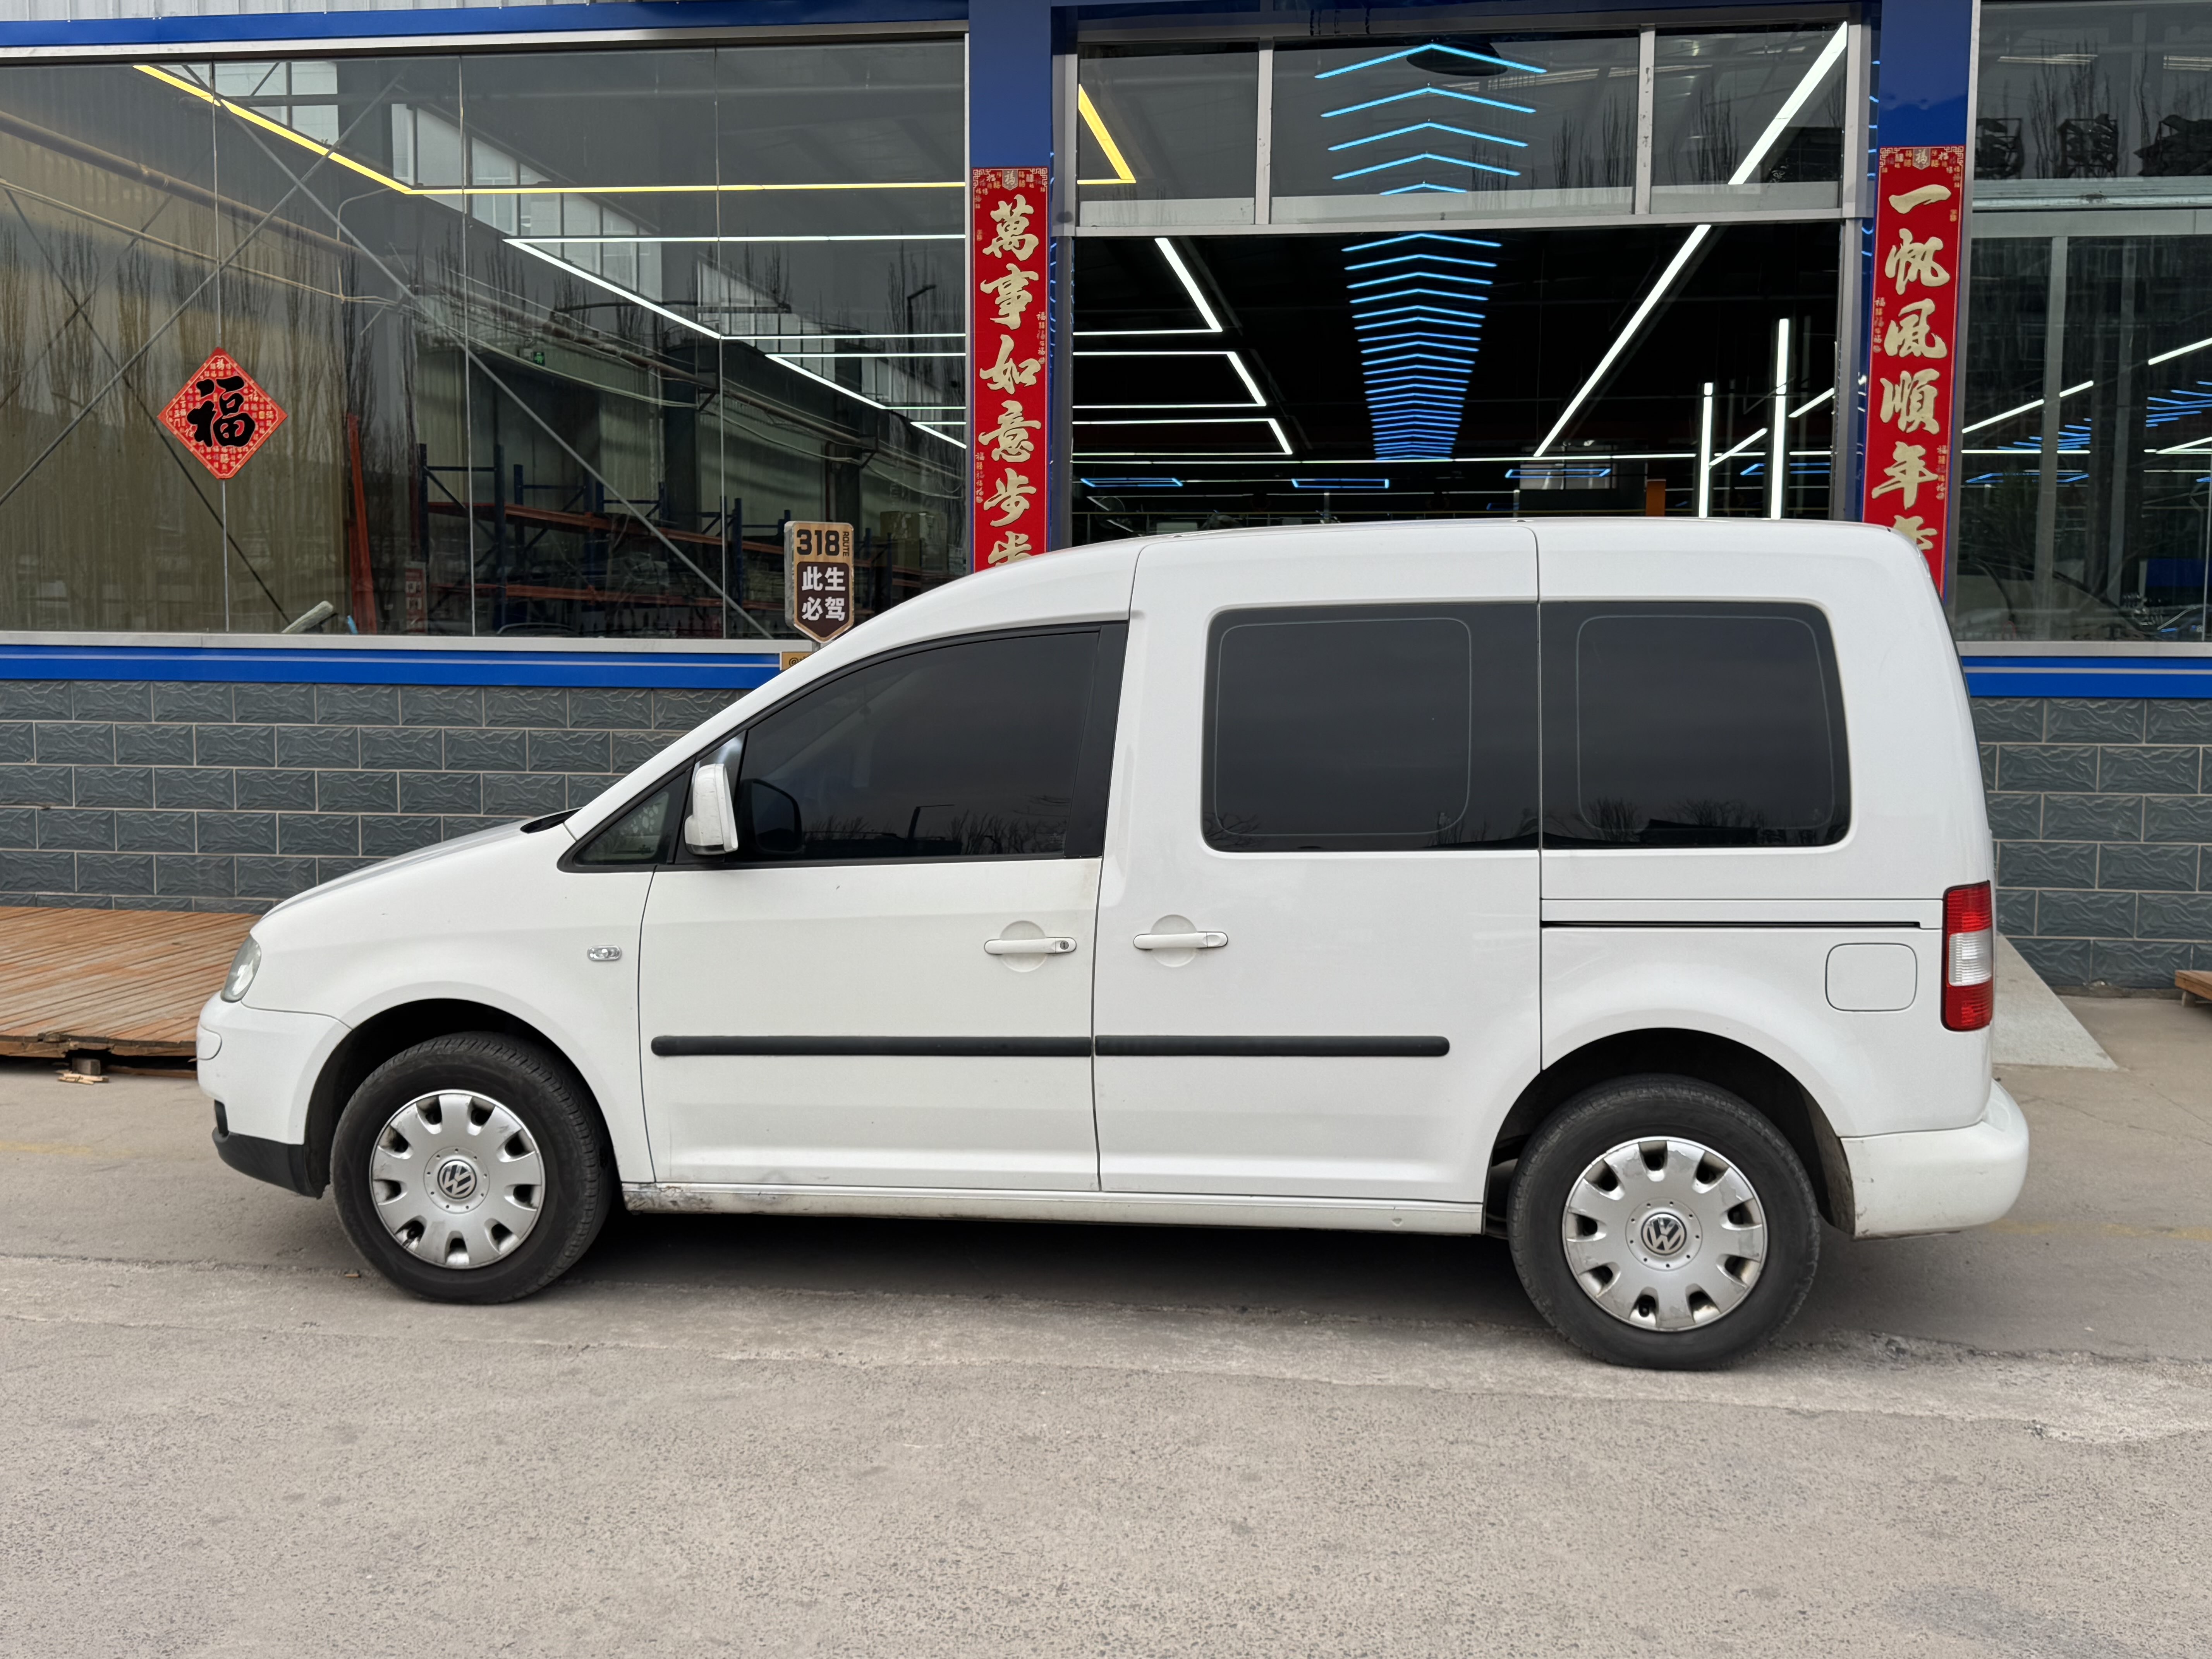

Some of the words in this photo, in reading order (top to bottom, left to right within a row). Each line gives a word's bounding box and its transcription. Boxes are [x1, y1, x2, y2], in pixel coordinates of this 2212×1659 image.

[187, 376, 256, 447] 福
[796, 529, 840, 556] 318
[801, 566, 846, 591] 此生
[801, 596, 846, 621] 必驾
[440, 1161, 474, 1197] VW
[1644, 1215, 1684, 1253] VW
